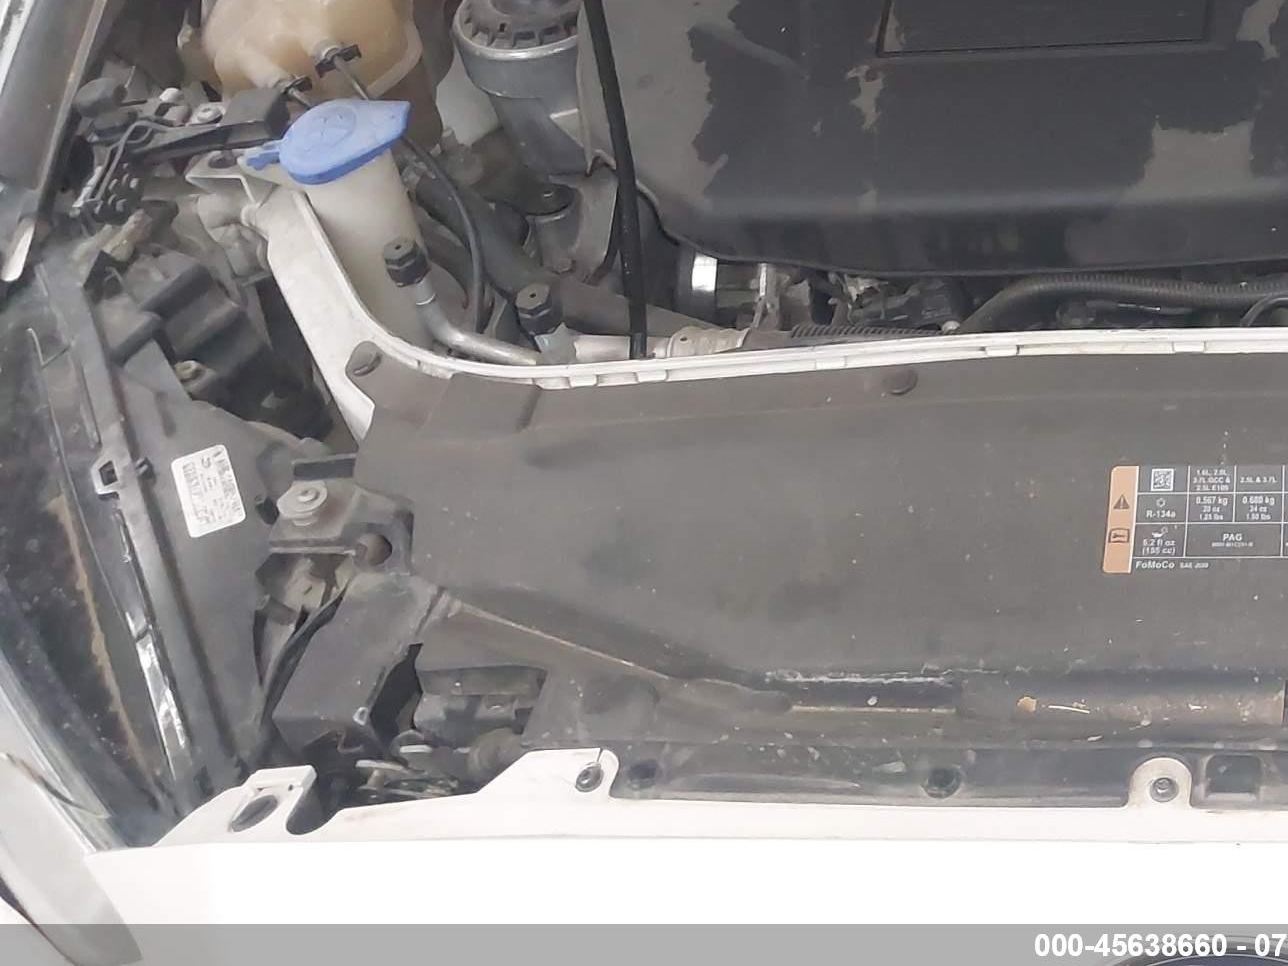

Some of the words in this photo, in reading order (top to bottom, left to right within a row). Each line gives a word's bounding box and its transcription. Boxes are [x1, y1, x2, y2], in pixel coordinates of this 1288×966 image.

[1218, 495, 1228, 506] kg
[1264, 495, 1275, 506] kg
[1146, 509, 1176, 518] R-134a
[1223, 533, 1243, 542] PAG
[1156, 538, 1163, 547] fl
[1162, 546, 1176, 555] cc)
[1135, 560, 1175, 569] FoMoCo
